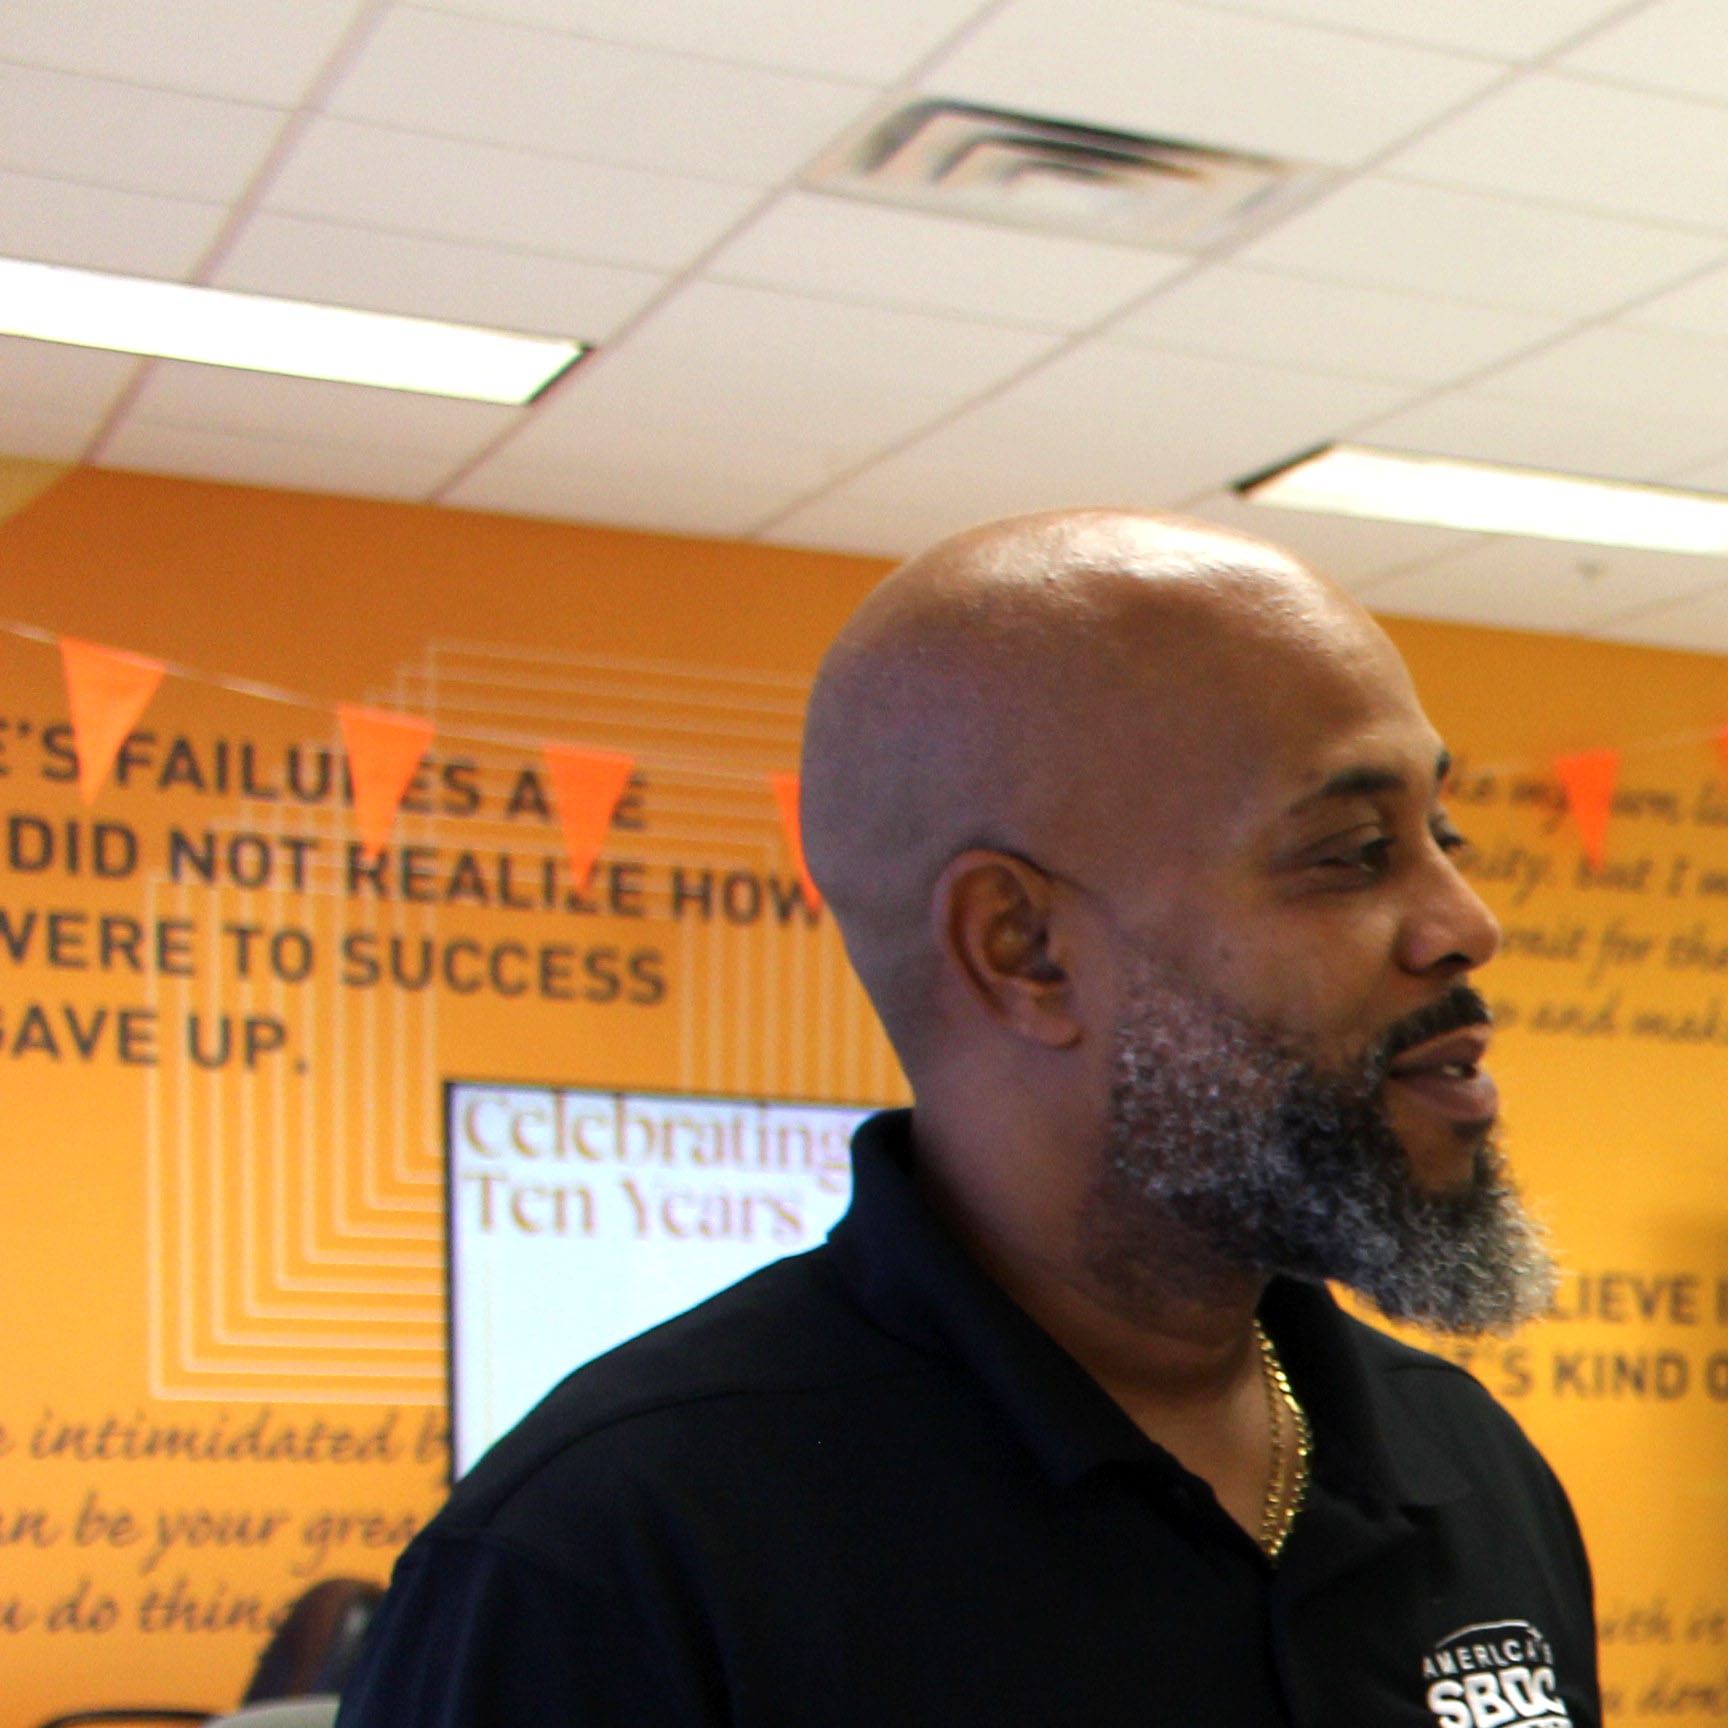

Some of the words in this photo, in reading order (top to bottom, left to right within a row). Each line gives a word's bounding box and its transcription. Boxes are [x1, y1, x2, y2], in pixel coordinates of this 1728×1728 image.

[115, 730, 480, 817] FAILUES
[505, 766, 648, 831] AE
[8, 814, 138, 878] DID
[169, 826, 318, 893] NOT
[222, 921, 314, 984] TO
[340, 930, 668, 1007] SUCCESS
[0, 1003, 158, 1068] AVE
[188, 1013, 310, 1076] UP.
[464, 1086, 852, 1194] Celebrating
[463, 1172, 598, 1237] Ten
[620, 1176, 805, 1243] Years
[1553, 1350, 1691, 1401] KIND
[30, 1406, 400, 1463] intimidated
[75, 1492, 142, 1549] be
[140, 1506, 290, 1577] your
[46, 1575, 119, 1633] do
